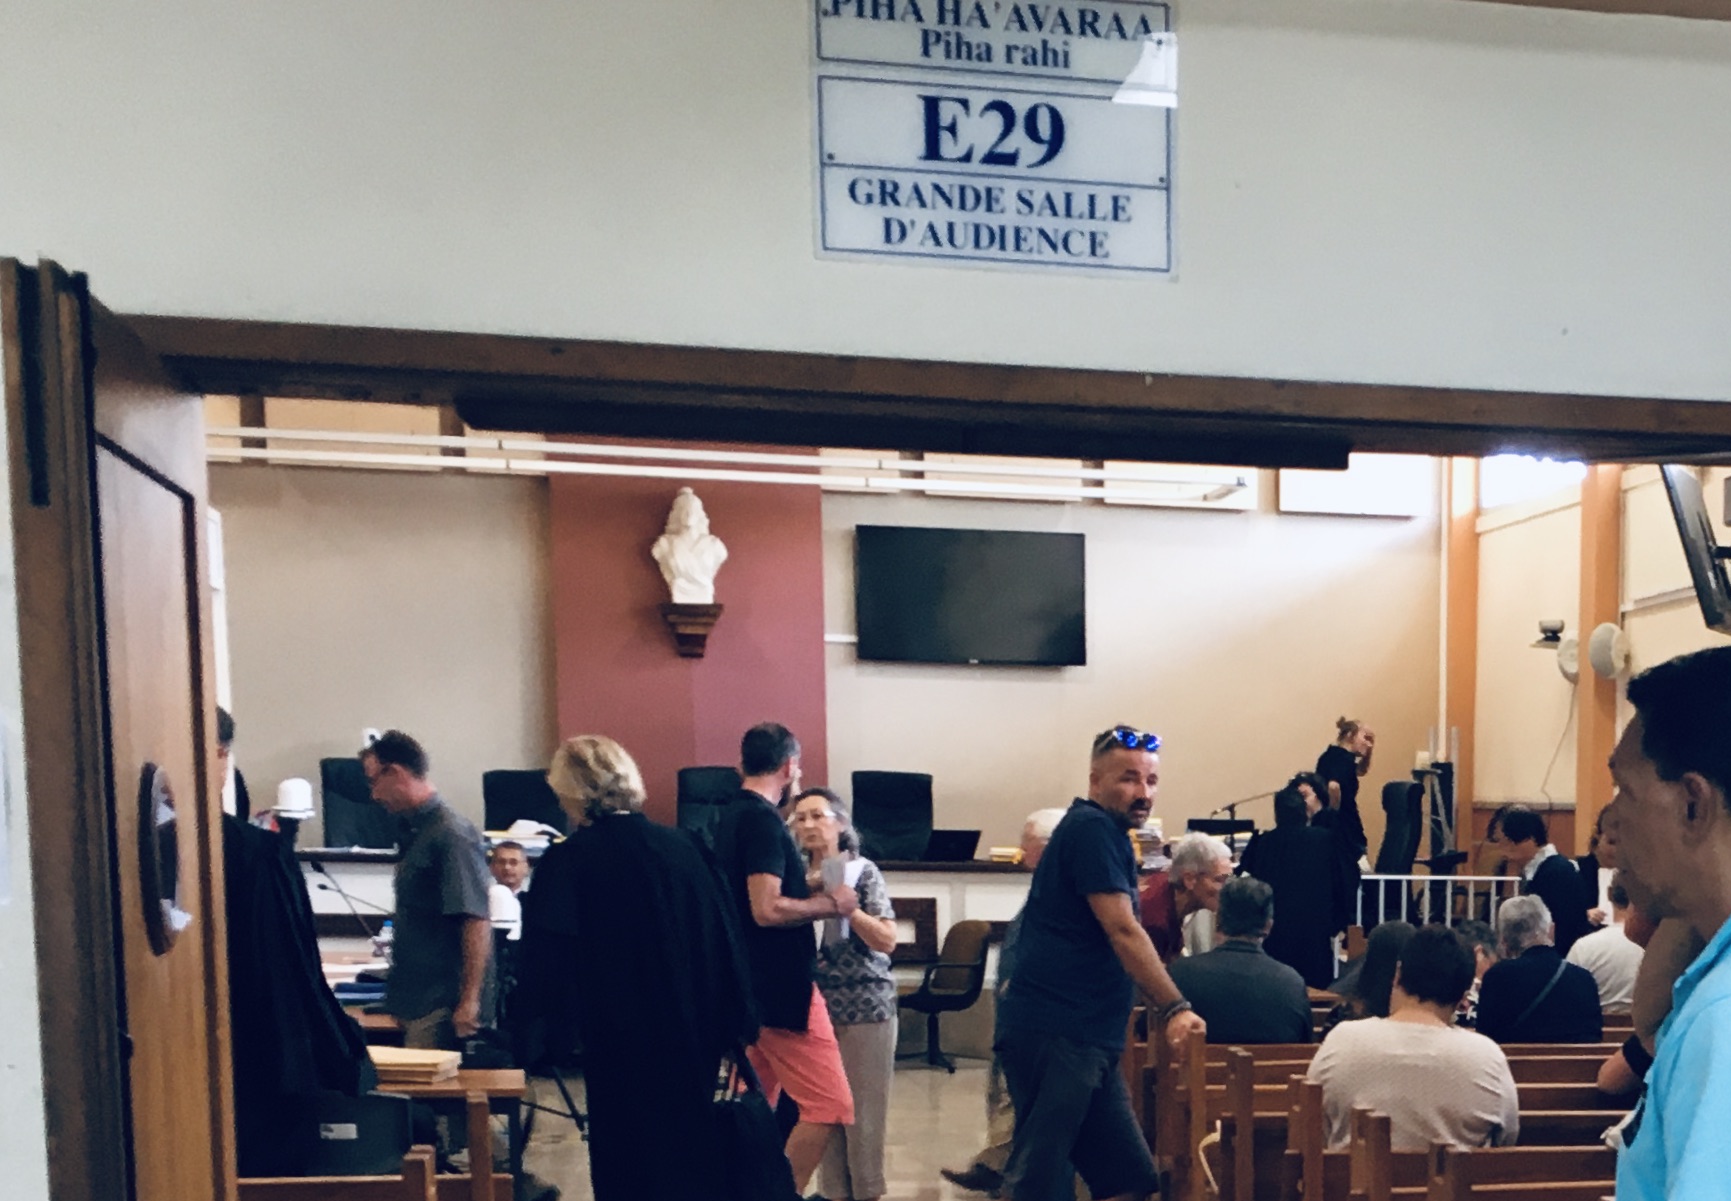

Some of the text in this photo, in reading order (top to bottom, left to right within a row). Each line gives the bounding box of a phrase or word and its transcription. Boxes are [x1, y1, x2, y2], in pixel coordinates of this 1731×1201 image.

[936, 0, 1152, 41] HA'AVARAA
[920, 28, 1071, 69] Piha rahi
[917, 94, 1066, 169] E29
[848, 176, 1132, 223] GRANDE SALLE
[882, 216, 1110, 259] D'AUDIENCE
